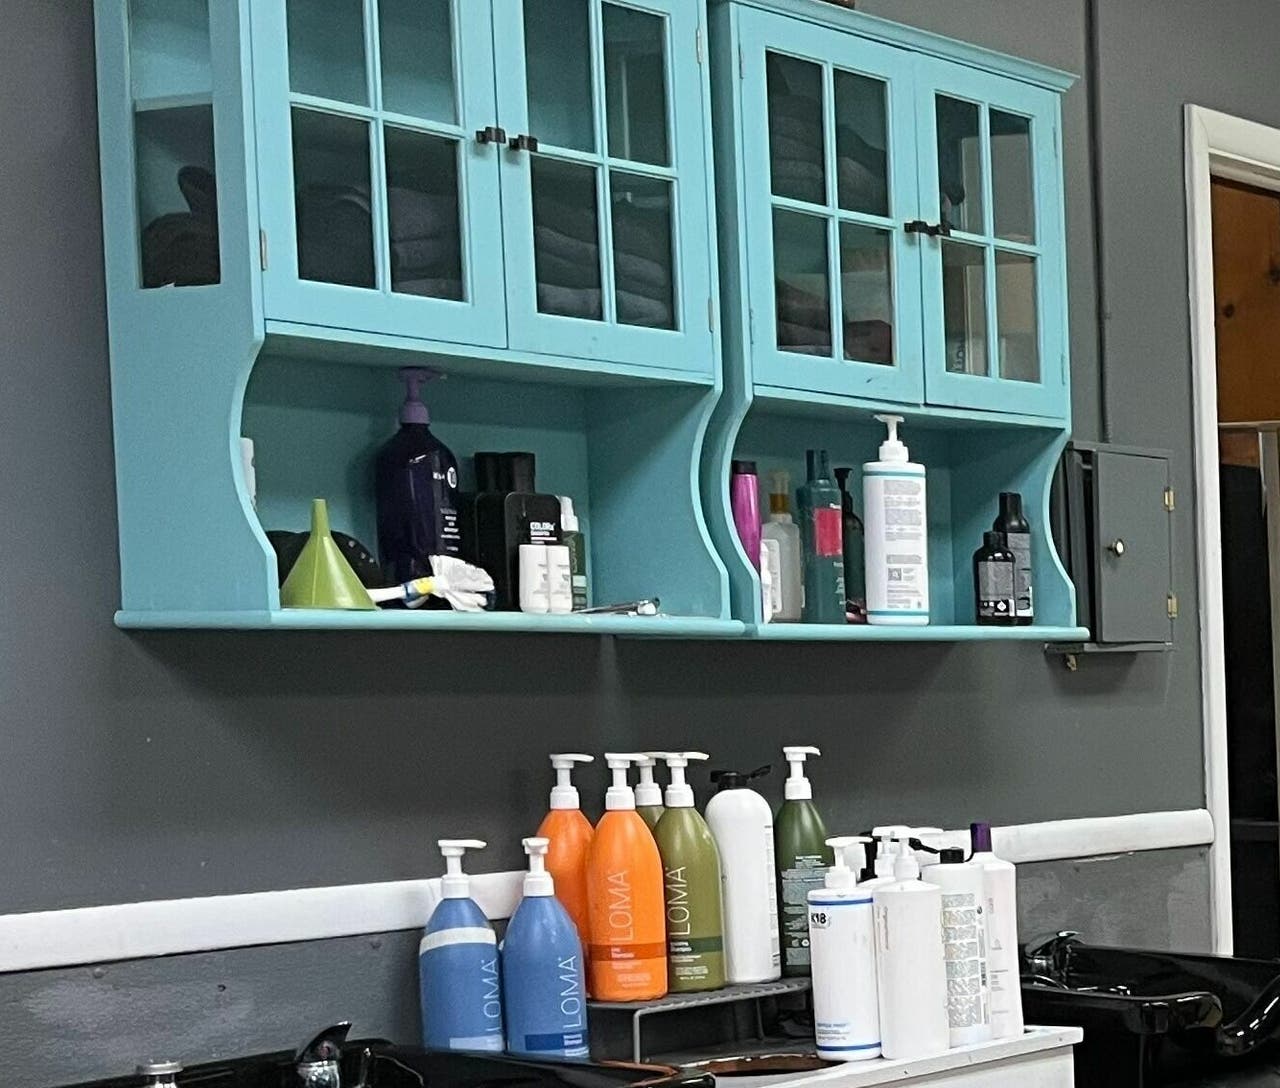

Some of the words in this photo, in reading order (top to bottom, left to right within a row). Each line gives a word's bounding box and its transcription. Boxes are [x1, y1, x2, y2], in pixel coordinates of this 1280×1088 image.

[607, 870, 634, 941] LOMA
[665, 866, 691, 936] LOMA
[558, 955, 583, 1030] LOMA
